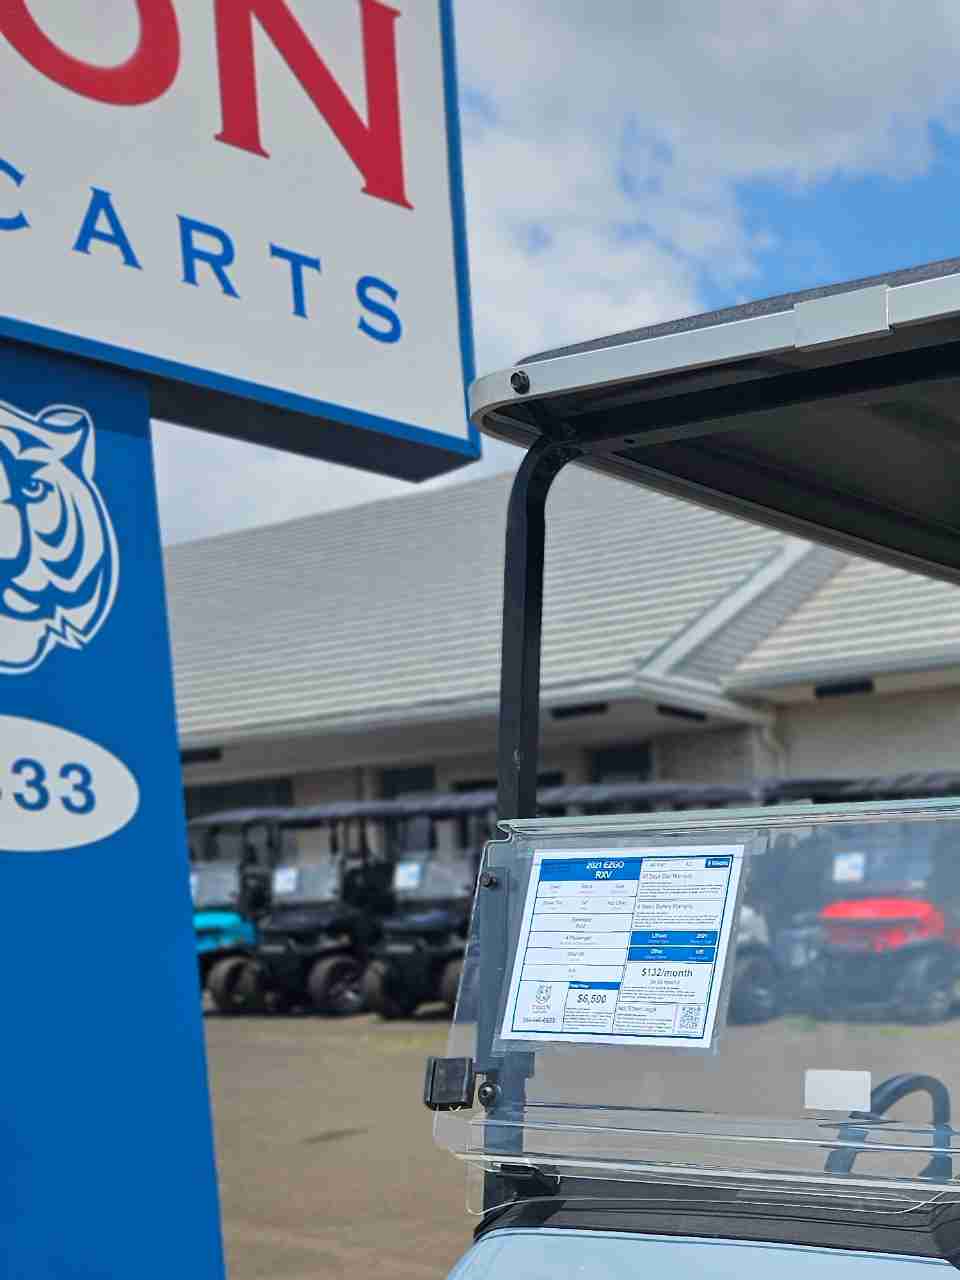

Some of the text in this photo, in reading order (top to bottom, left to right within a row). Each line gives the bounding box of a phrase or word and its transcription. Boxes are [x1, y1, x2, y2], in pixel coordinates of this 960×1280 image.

[0, 757, 97, 815] 33
[595, 870, 613, 880] RXV
[641, 966, 693, 978] $132/month
[577, 992, 608, 1005] $6,500
